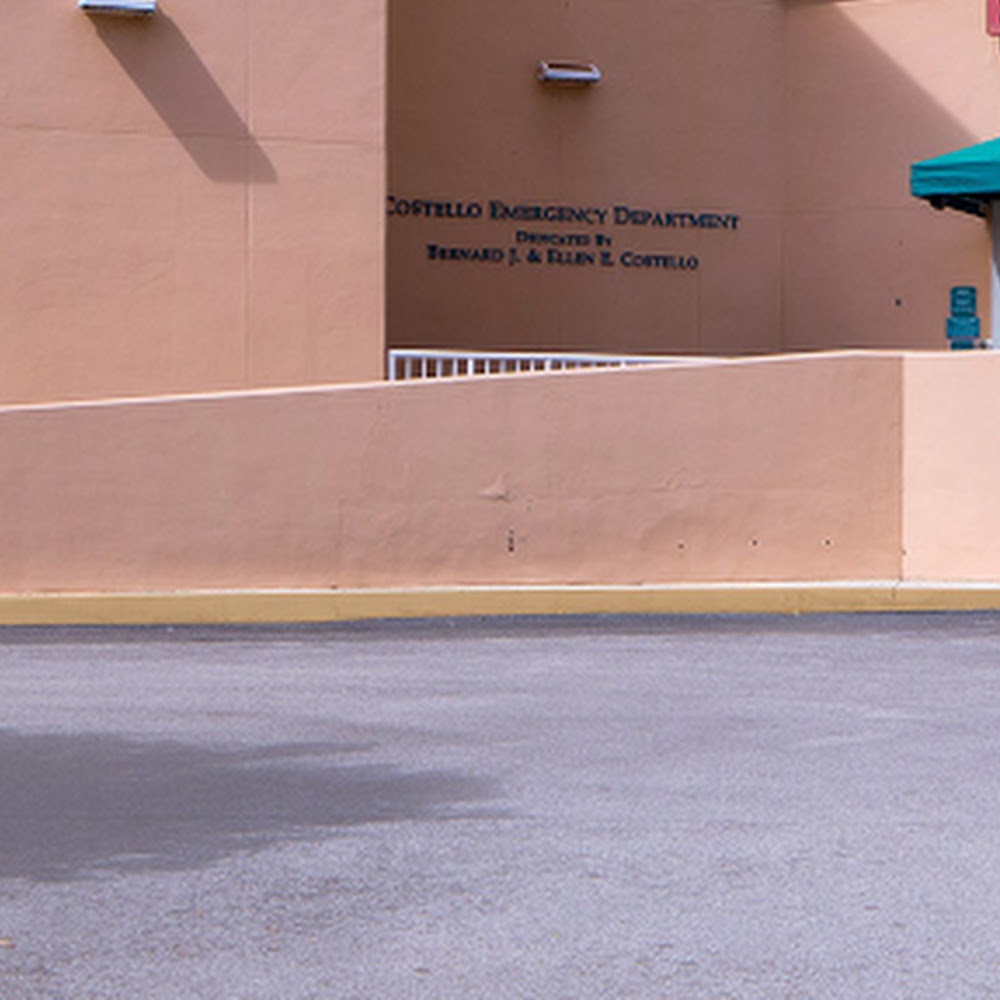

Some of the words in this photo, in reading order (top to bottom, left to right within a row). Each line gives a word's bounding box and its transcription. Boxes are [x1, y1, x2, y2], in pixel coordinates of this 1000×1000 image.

[489, 200, 607, 225] EMERGENCY
[613, 205, 740, 230] DEPARTMENT
[427, 244, 504, 261] BERNARD
[527, 249, 541, 264] &
[547, 249, 595, 265] ELLEN
[620, 251, 699, 270] COSTELLO
